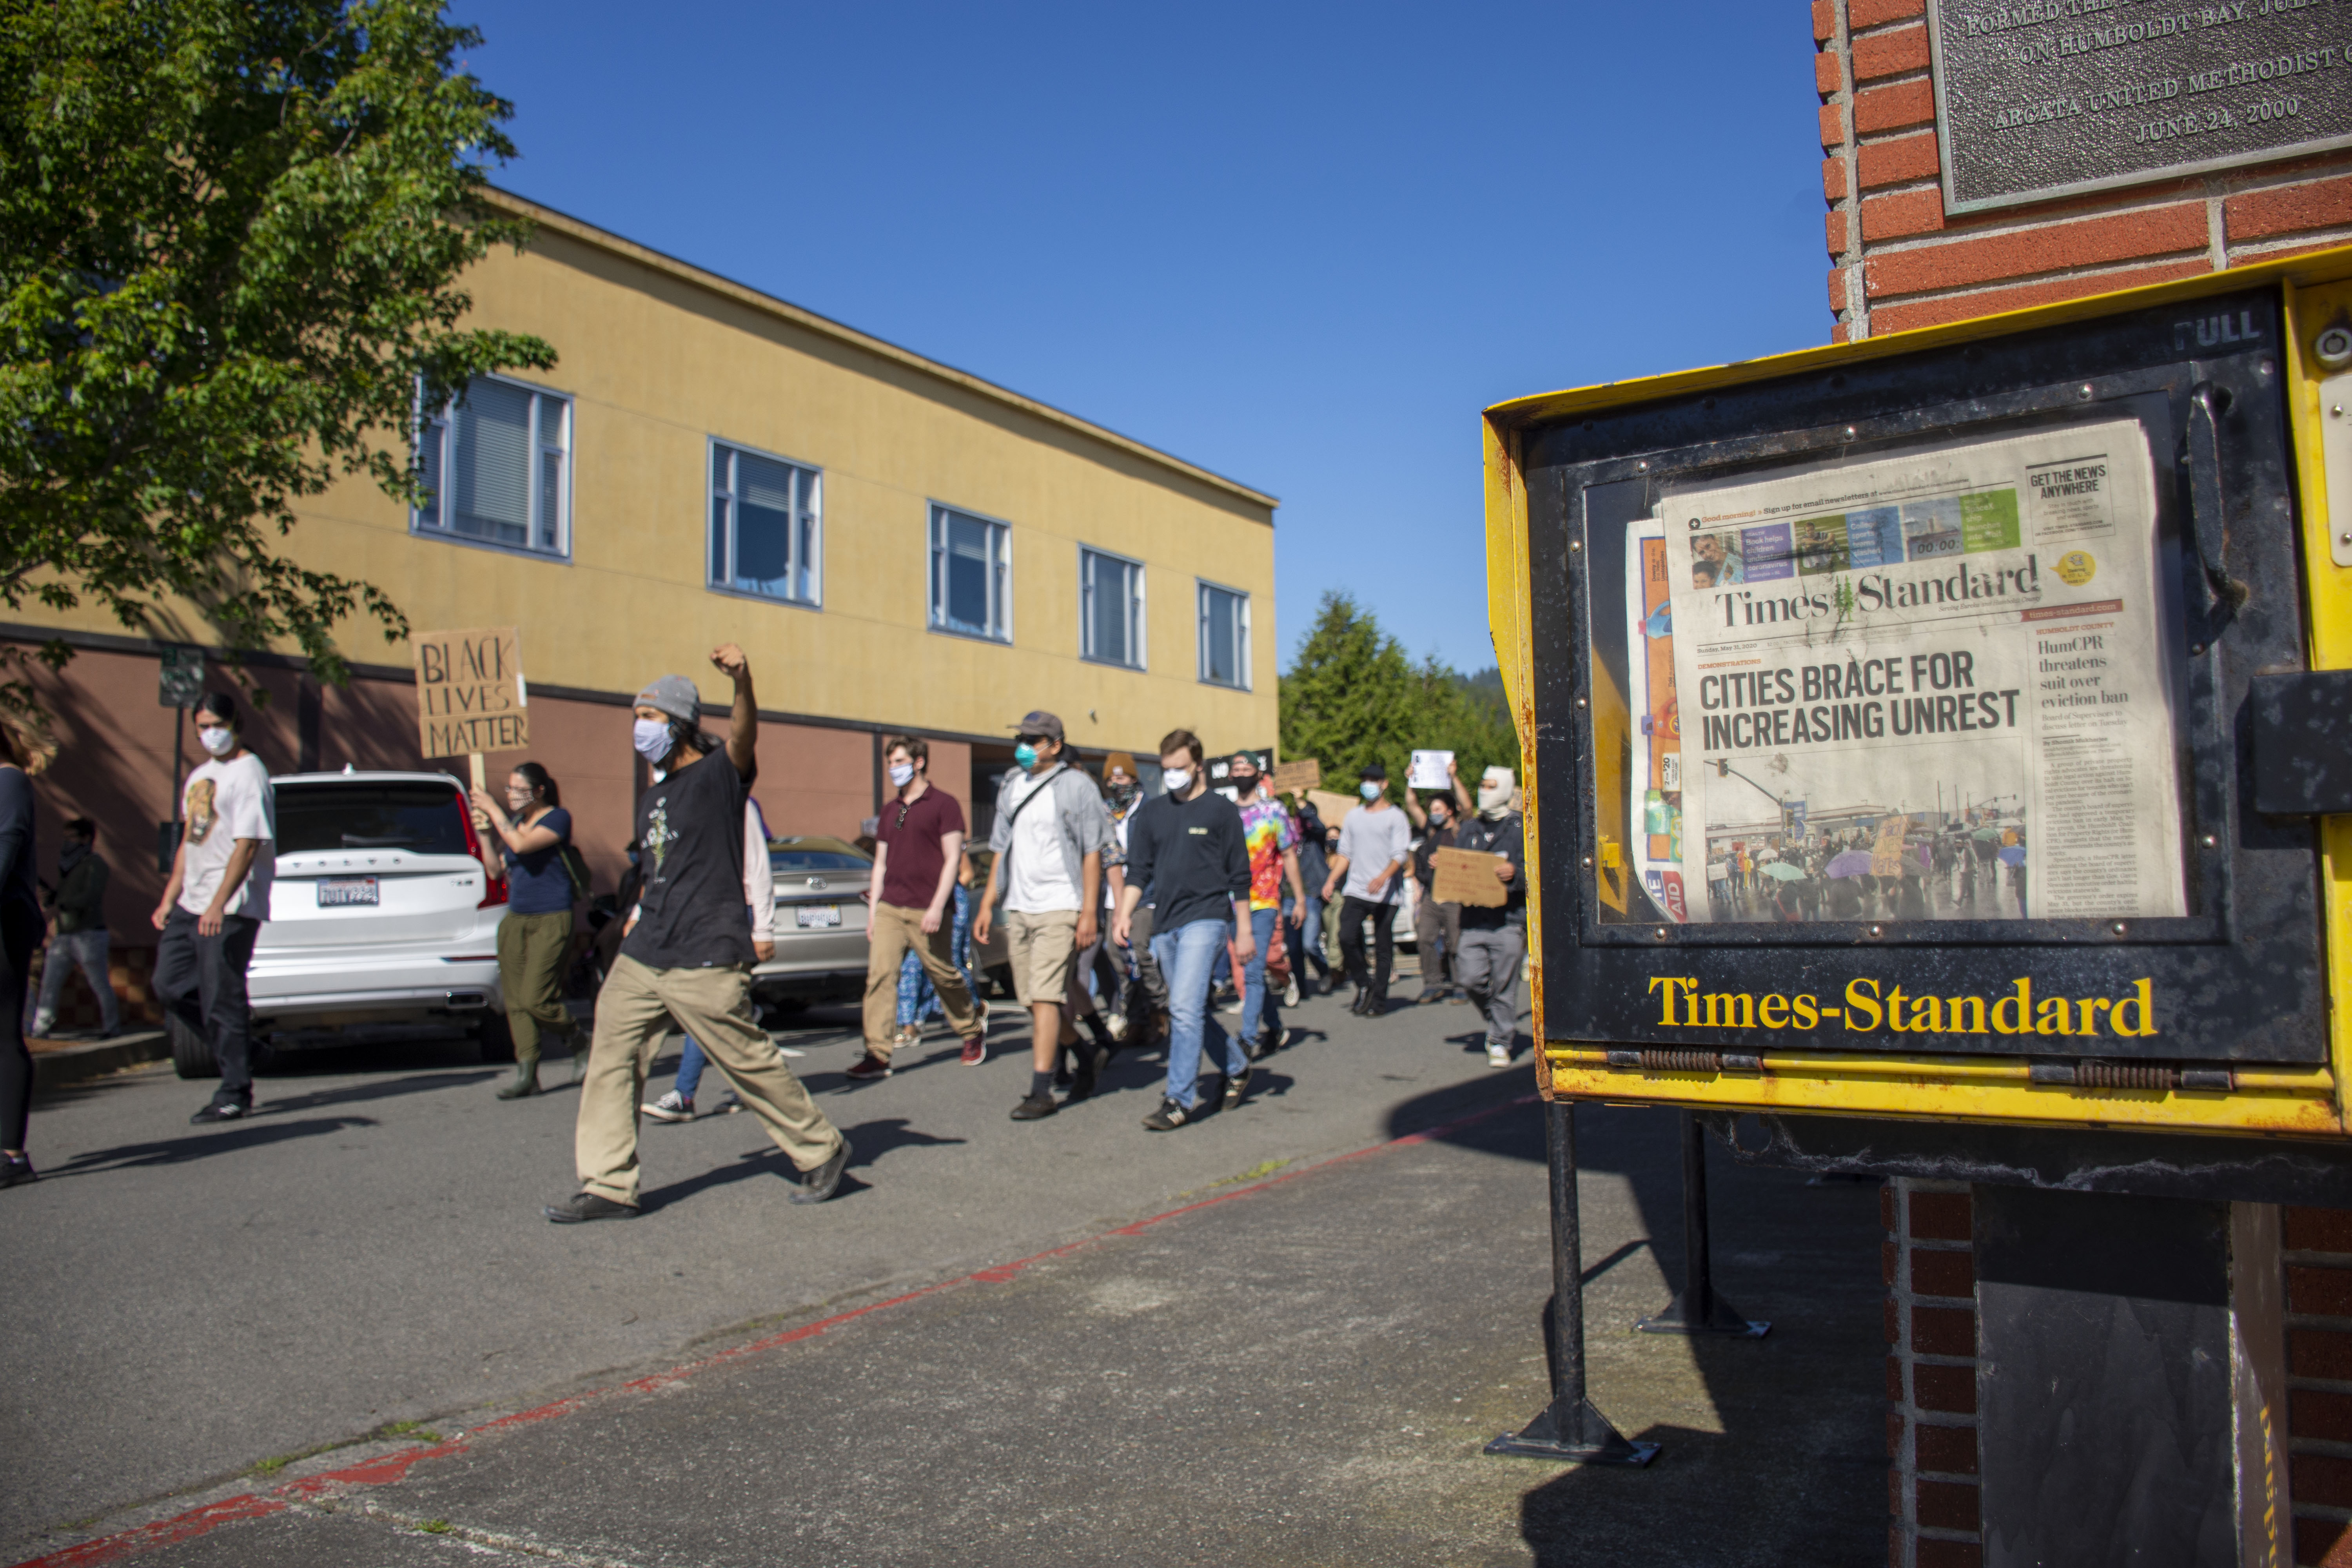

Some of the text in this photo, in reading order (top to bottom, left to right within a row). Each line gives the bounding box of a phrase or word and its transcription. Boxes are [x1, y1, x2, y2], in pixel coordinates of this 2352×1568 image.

[1966, 0, 2112, 36] FORMED THE
[2019, 0, 2321, 64] ON HUMBOLDT BAY, JUL
[1994, 98, 2081, 130] ARCATA
[2088, 80, 2178, 111] UNITED
[2188, 48, 2335, 94] METHODIST
[2135, 98, 2298, 144] JUNE 24, 2000
[2174, 311, 2260, 351] PULL
[2030, 465, 2106, 487] GET THE NEWS
[2041, 479, 2099, 499] ANYWHERE
[1701, 514, 1721, 523] Good
[1722, 510, 1755, 520] morning!
[1803, 498, 1824, 508] email
[1825, 492, 1869, 505] newsletters
[1746, 535, 1783, 545] Book helps
[1746, 545, 1774, 554] children
[1747, 552, 1786, 563] understand
[1748, 561, 1788, 571] coronavirus
[1715, 554, 2041, 627] Times Standard
[1939, 604, 1960, 612] Serving
[1993, 597, 2021, 606] Humboldt
[2022, 595, 2042, 603] County
[2029, 602, 2116, 619] times-standard.com
[2036, 622, 2114, 635] HUMBOLDT COUNTY
[2038, 635, 2104, 655] HumCPR
[421, 635, 515, 684] BLACK
[1698, 659, 1761, 670] DEMONSTRATIONS
[2039, 657, 2107, 673] threatens
[1700, 650, 1974, 710] CITIES BRACE FOR
[2040, 675, 2101, 691] suit over
[426, 684, 510, 715] LIVES
[2041, 690, 2129, 708] eviction ban
[1702, 689, 2020, 751] INCREASING UNREST
[2042, 713, 2063, 722] Board
[2064, 712, 2073, 720] of
[2073, 710, 2113, 720] Supervisors
[2042, 723, 2067, 731] discuss
[2068, 721, 2087, 729] letter
[2099, 719, 2127, 728] Tuesday
[429, 715, 528, 757] MATTER
[1657, 808, 1666, 833] Pampers
[1668, 882, 1683, 915] AID
[1649, 976, 2157, 1037] Times-Standard
